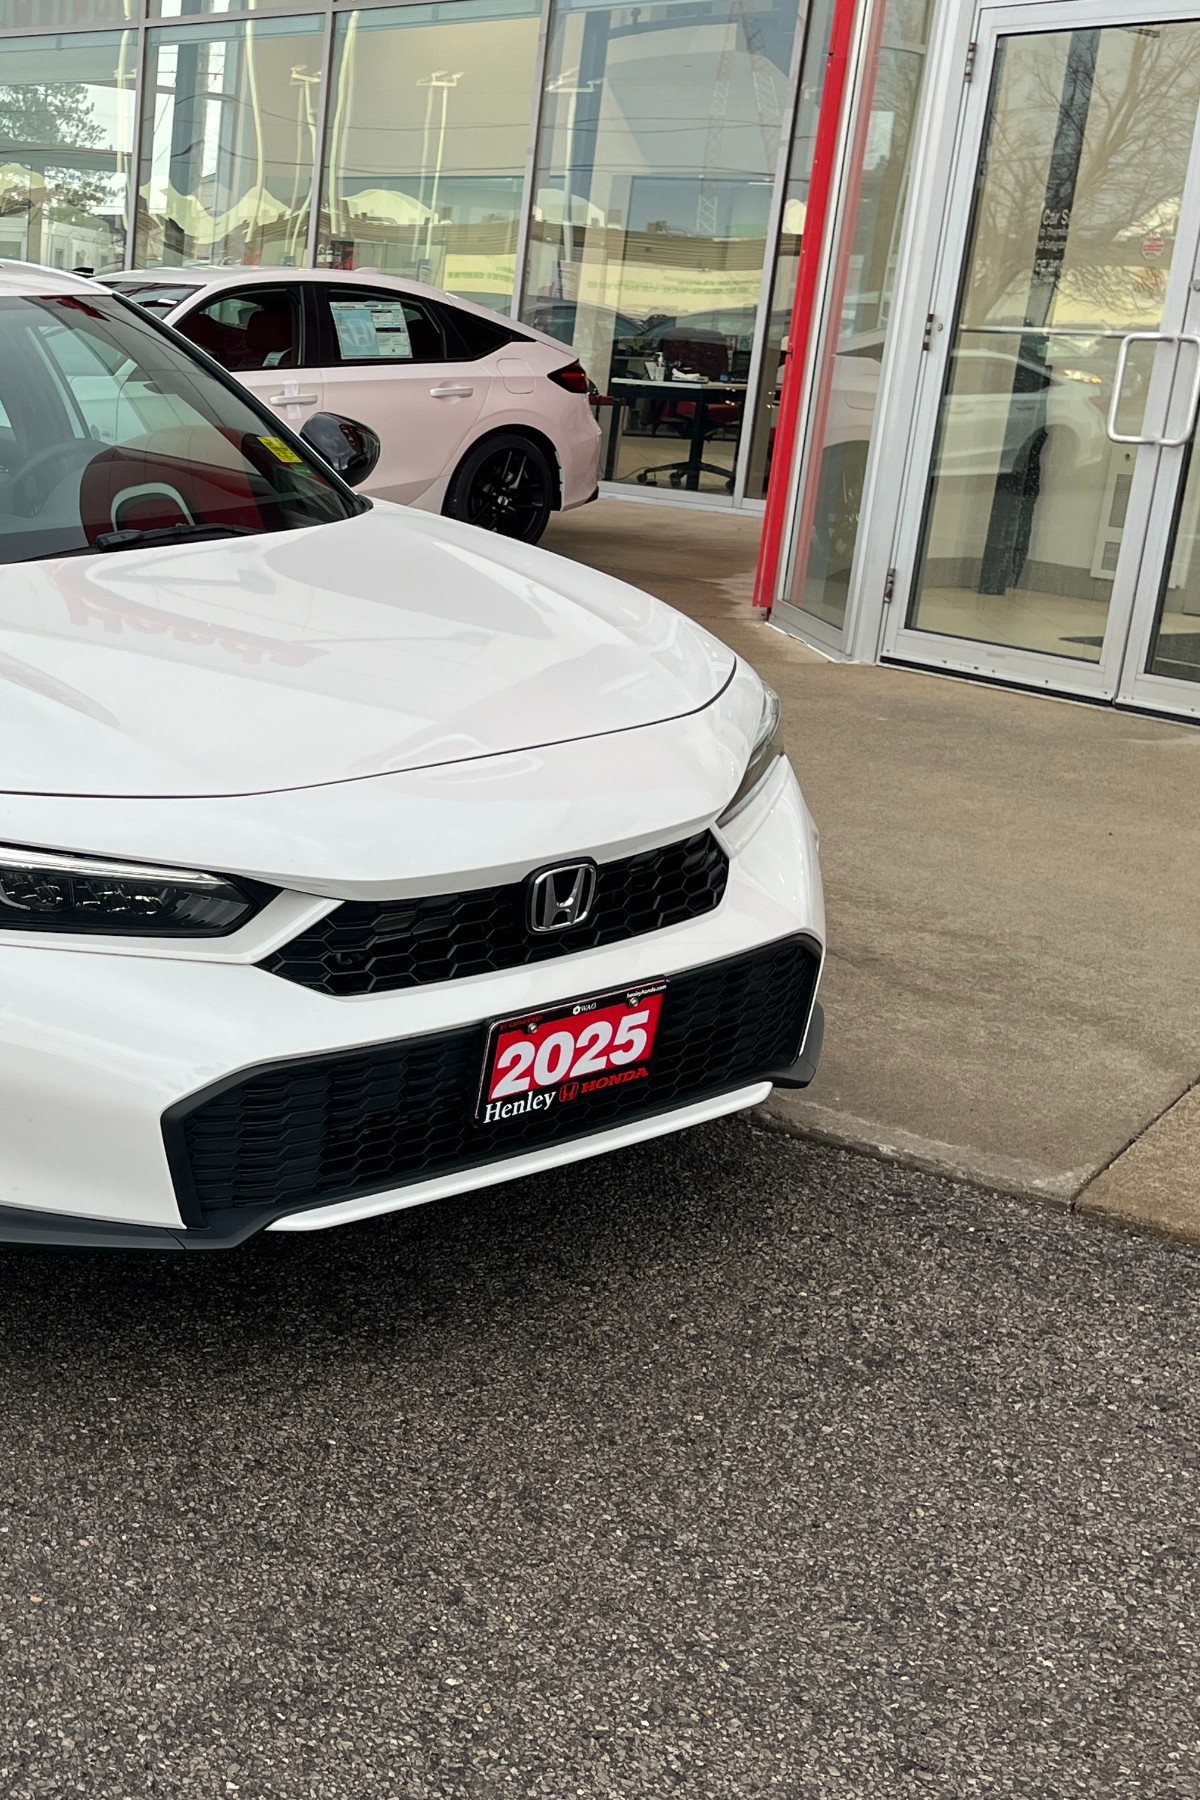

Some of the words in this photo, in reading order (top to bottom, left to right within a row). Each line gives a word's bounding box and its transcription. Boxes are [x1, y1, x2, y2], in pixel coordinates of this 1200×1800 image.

[491, 1010, 649, 1099] 2025
[483, 1091, 556, 1123] Henley
[581, 1067, 649, 1093] HONDA
